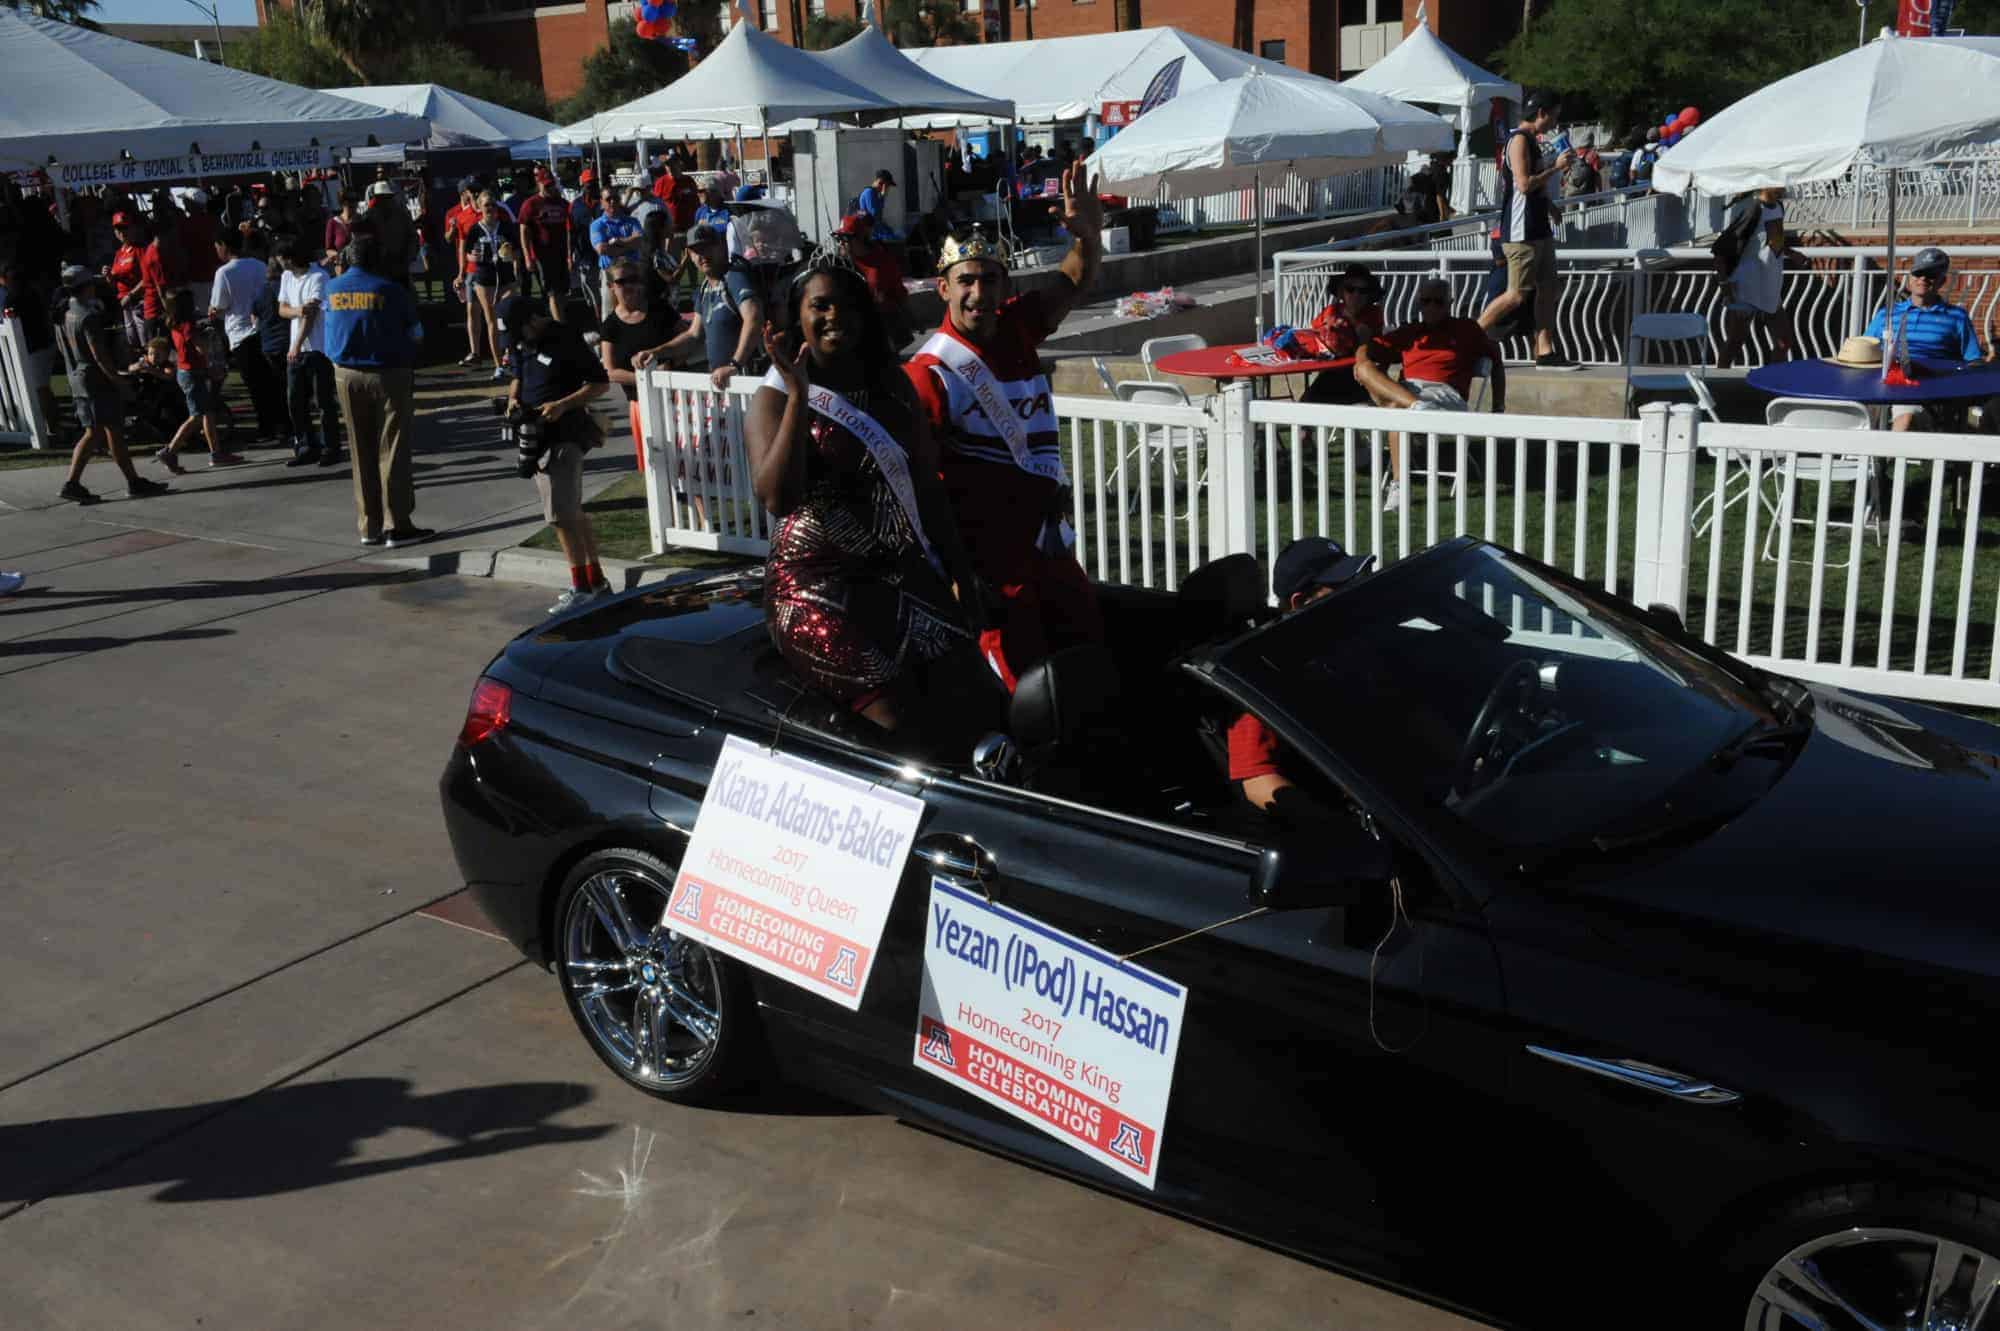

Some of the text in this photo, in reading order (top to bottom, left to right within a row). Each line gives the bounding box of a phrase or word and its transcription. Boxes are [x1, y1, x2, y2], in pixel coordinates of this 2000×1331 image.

[62, 162, 116, 183] COLLEGE
[121, 161, 137, 179] OF
[143, 158, 184, 177] SOCIAL
[201, 152, 267, 173] BEHAVIORAL
[271, 149, 320, 169] SCIENCES
[711, 760, 904, 869] Kiana Adams-Baker
[706, 848, 860, 925] Homecoming Queen
[772, 845, 809, 873] 2017
[709, 913, 821, 972] CELEBRATION
[713, 895, 825, 953] HOMECOMING
[934, 903, 1170, 1056] Yezan (IPod) Hassan
[957, 1002, 1123, 1104] Homecoming King
[1021, 1008, 1063, 1041] 2017
[967, 1062, 1099, 1142] CELEBRATION
[968, 1044, 1102, 1123] HOMECOMING
